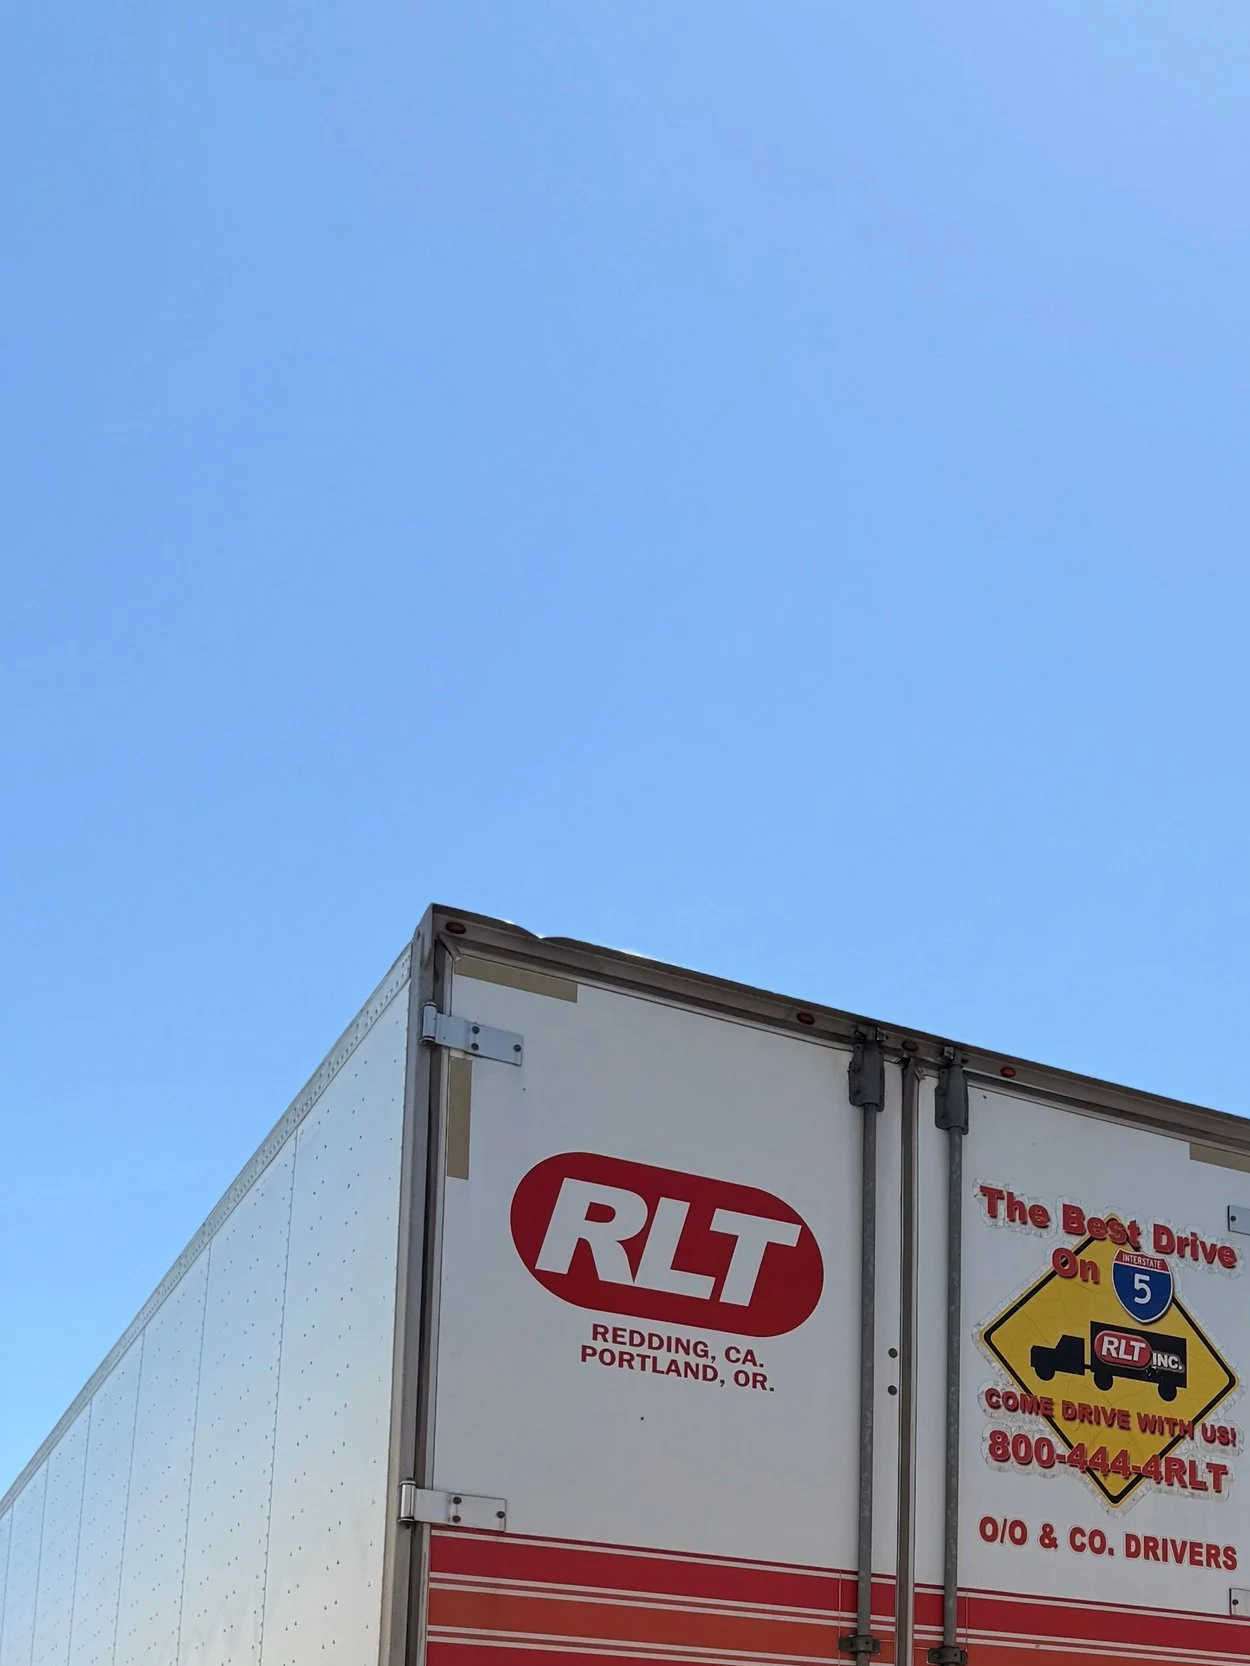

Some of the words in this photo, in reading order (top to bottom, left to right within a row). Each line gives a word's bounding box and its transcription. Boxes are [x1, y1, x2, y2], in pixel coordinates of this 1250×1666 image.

[535, 1177, 802, 1307] RLT
[979, 1185, 1051, 1229] The
[1062, 1203, 1142, 1251] Best
[1153, 1224, 1238, 1269] Drive
[1051, 1247, 1100, 1284] On
[1121, 1252, 1163, 1270] INTERSTATE
[1132, 1273, 1152, 1305] 5
[580, 1345, 725, 1388] PORTLAND,
[733, 1369, 776, 1392] OR.
[592, 1323, 718, 1361] REDDING,
[724, 1345, 765, 1368] CA.
[1100, 1335, 1146, 1362] RLT
[1151, 1351, 1183, 1371] INC.
[984, 1386, 1055, 1417] COME
[1061, 1397, 1131, 1430] DRIVE
[1136, 1412, 1196, 1440] WITH
[1200, 1422, 1238, 1448] US!
[988, 1429, 1229, 1494] 800-444-4RLT
[979, 1515, 1028, 1546] O/O
[1038, 1523, 1059, 1550] &
[1069, 1526, 1116, 1557] CO.
[1124, 1532, 1238, 1571] DRIVERS
